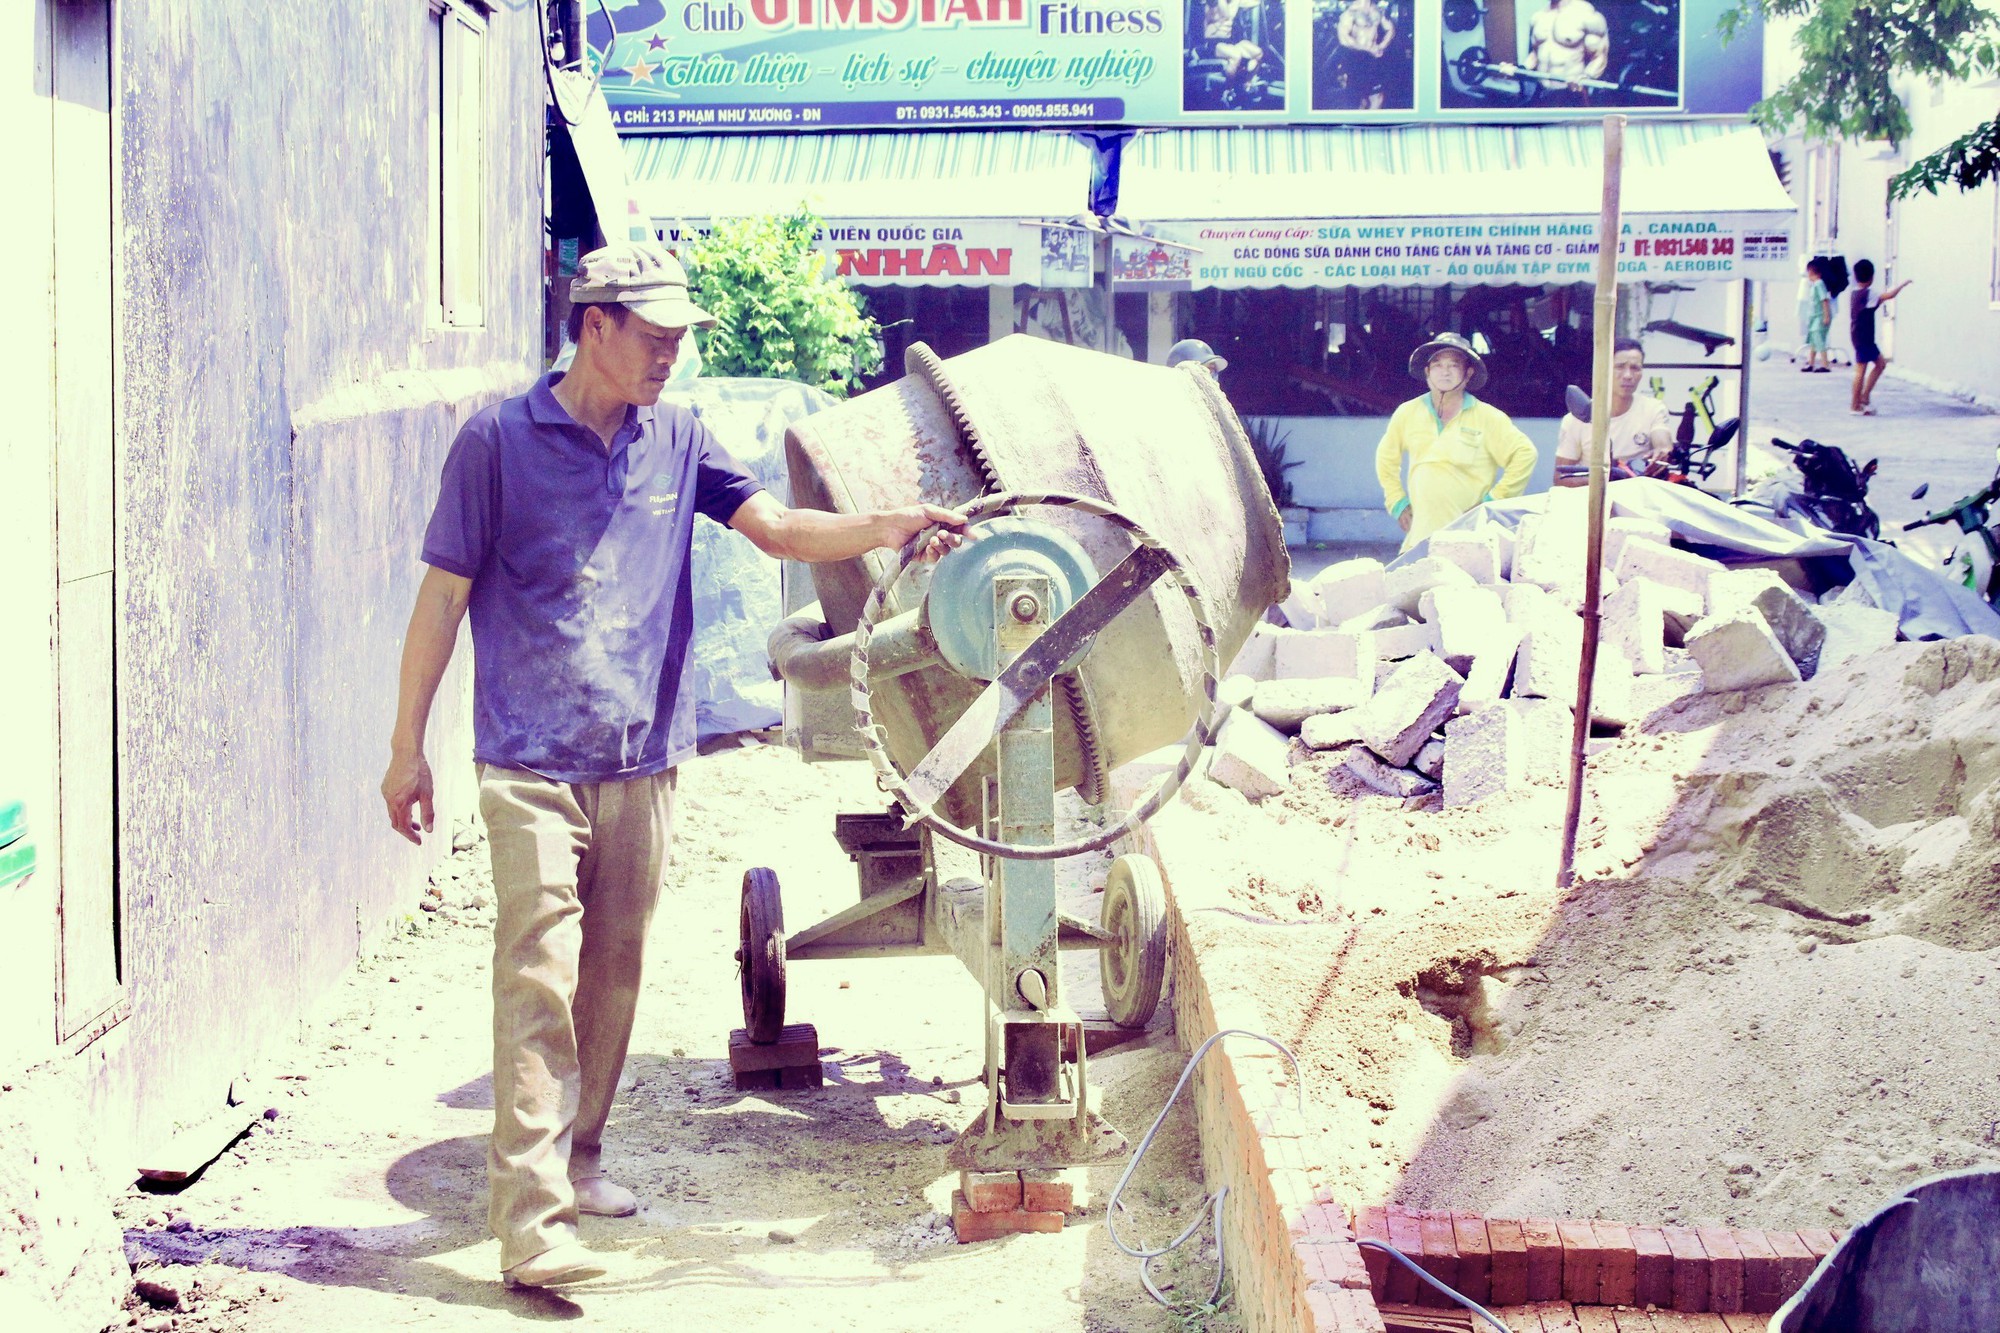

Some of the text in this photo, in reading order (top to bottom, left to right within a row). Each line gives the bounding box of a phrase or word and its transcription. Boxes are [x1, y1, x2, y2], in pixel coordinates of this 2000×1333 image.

[683, 2, 745, 32] Club
[1039, 3, 1163, 35] Fitness
[664, 52, 737, 87] Thân
[744, 52, 810, 90] thiện
[842, 52, 892, 90] lịch
[899, 55, 936, 88] sự
[966, 50, 1059, 88] chuyên
[1064, 48, 1155, 86] nghiệp
[652, 109, 676, 123] 213
[678, 108, 715, 126] PHẠM
[718, 107, 747, 122] NHƯ
[748, 106, 793, 122] XƯƠNG
[802, 108, 822, 121] ĐN
[896, 106, 918, 120] ĐT:
[919, 105, 1002, 119] 0931.546.343
[1012, 103, 1095, 118] 0905.855.941
[829, 225, 871, 241] VIÊN
[877, 223, 926, 242] QUỐC
[932, 227, 963, 241] GIA
[1249, 228, 1283, 241] Cung
[1285, 226, 1315, 240] Cấp:
[1317, 225, 1351, 239] SỮA
[1357, 226, 1406, 239] WHEY
[1411, 225, 1483, 238] PROTEIN
[1489, 222, 1541, 237] CHÍNH
[835, 242, 1013, 276] NHÂN
[1233, 245, 1260, 259] CÁC
[1304, 244, 1331, 258] SỮA
[1375, 245, 1401, 257] CHO
[1535, 242, 1553, 255] CƠ
[1200, 264, 1229, 280] BỘT
[1272, 261, 1304, 278] CỐC
[1325, 262, 1357, 278] CÁC
[1361, 264, 1397, 279] LOẠI
[1401, 264, 1431, 279] HẠT
[1447, 261, 1469, 276] ÁO
[1556, 261, 1591, 274] GYM
[1617, 260, 1647, 273] OGA
[1664, 259, 1733, 273] AEROBIC
